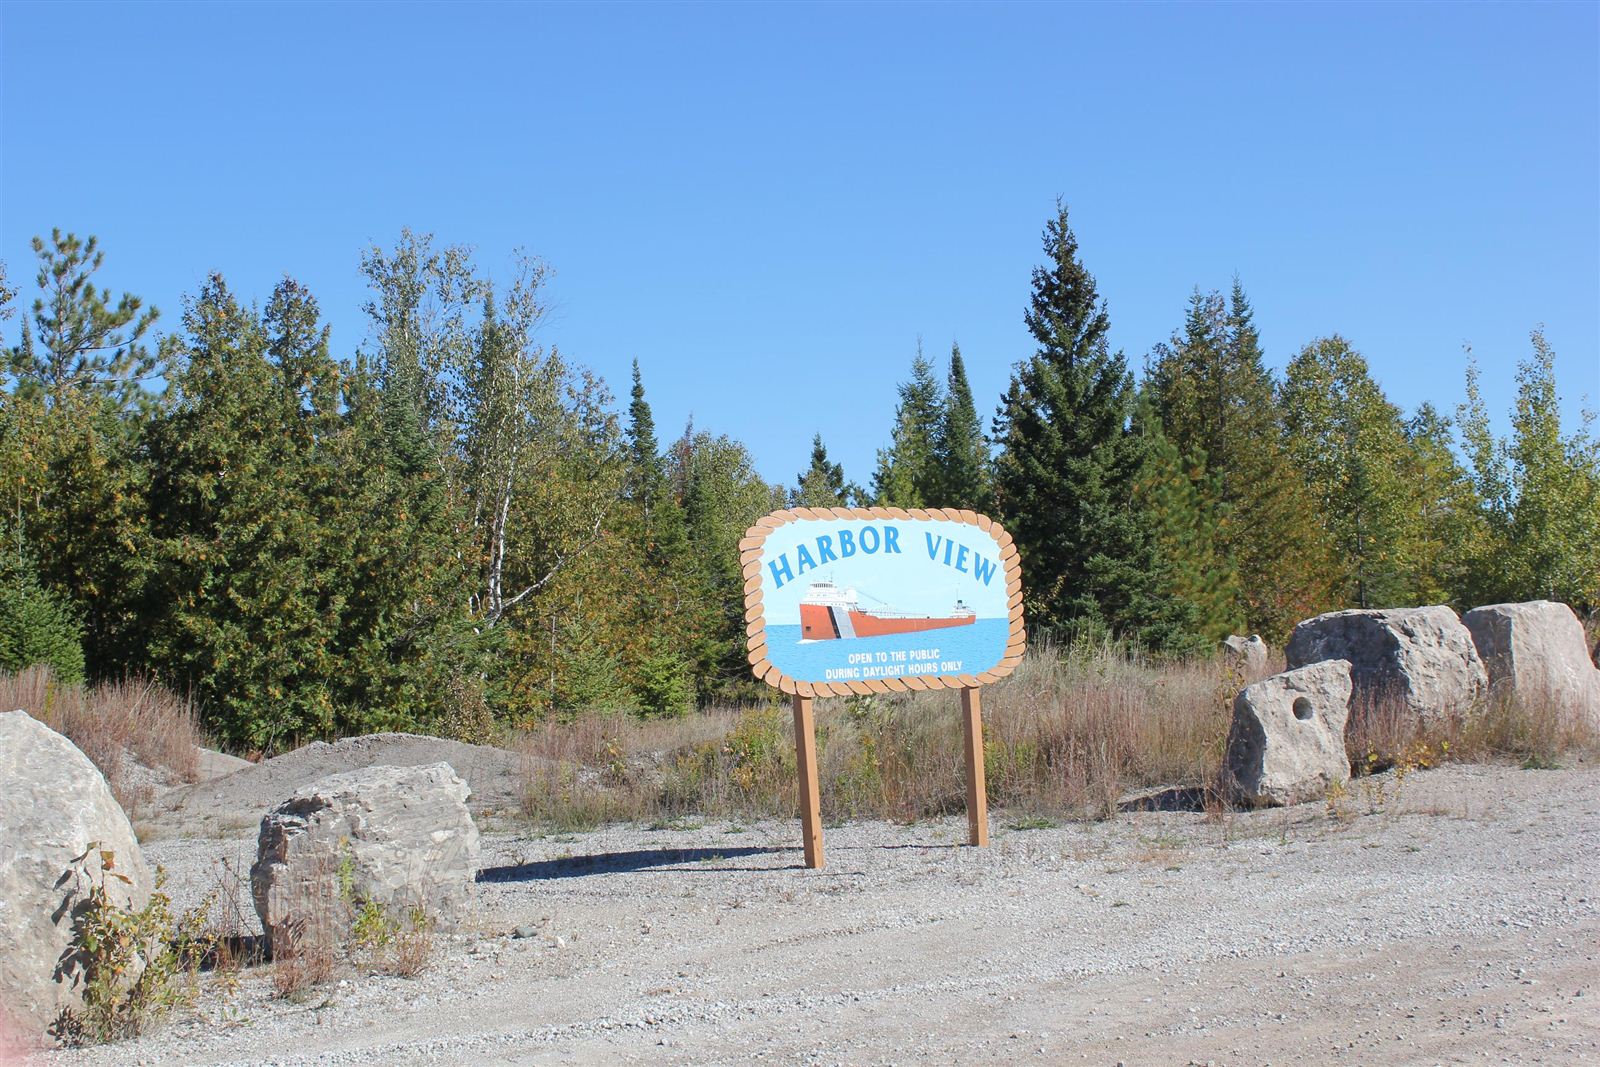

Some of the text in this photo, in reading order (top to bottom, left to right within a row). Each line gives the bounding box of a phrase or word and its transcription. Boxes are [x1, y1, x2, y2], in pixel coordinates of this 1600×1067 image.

[768, 525, 997, 589] HARBOR VIEW
[848, 648, 940, 664] OPEN TO THE PUBLIC
[825, 661, 962, 680] DURING DAYLIGHT HOURS ONLY
